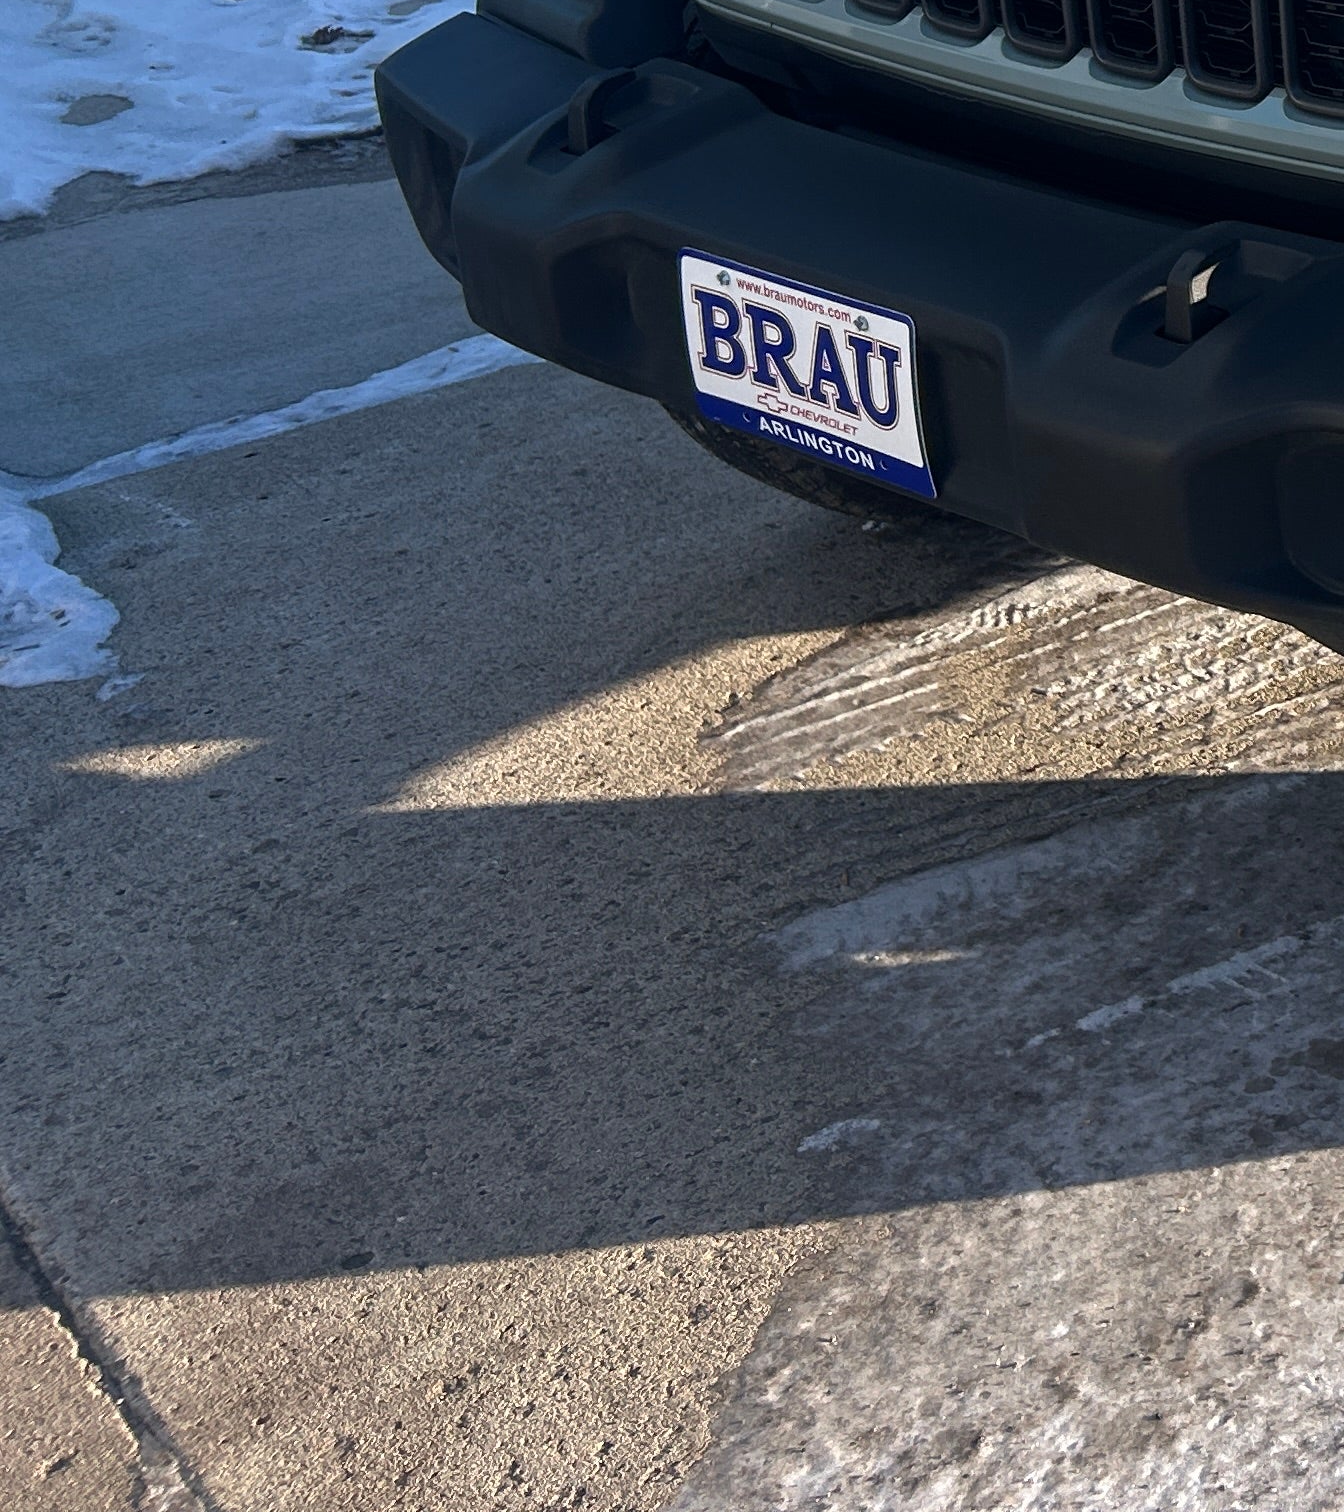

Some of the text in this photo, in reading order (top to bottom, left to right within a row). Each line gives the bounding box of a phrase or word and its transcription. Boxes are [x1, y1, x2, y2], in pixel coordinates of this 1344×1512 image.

[736, 278, 852, 323] www.braumotors.com
[690, 284, 902, 430] BRAU
[759, 416, 876, 471] ARLINGTON
[790, 404, 859, 437] CHEVROLET
